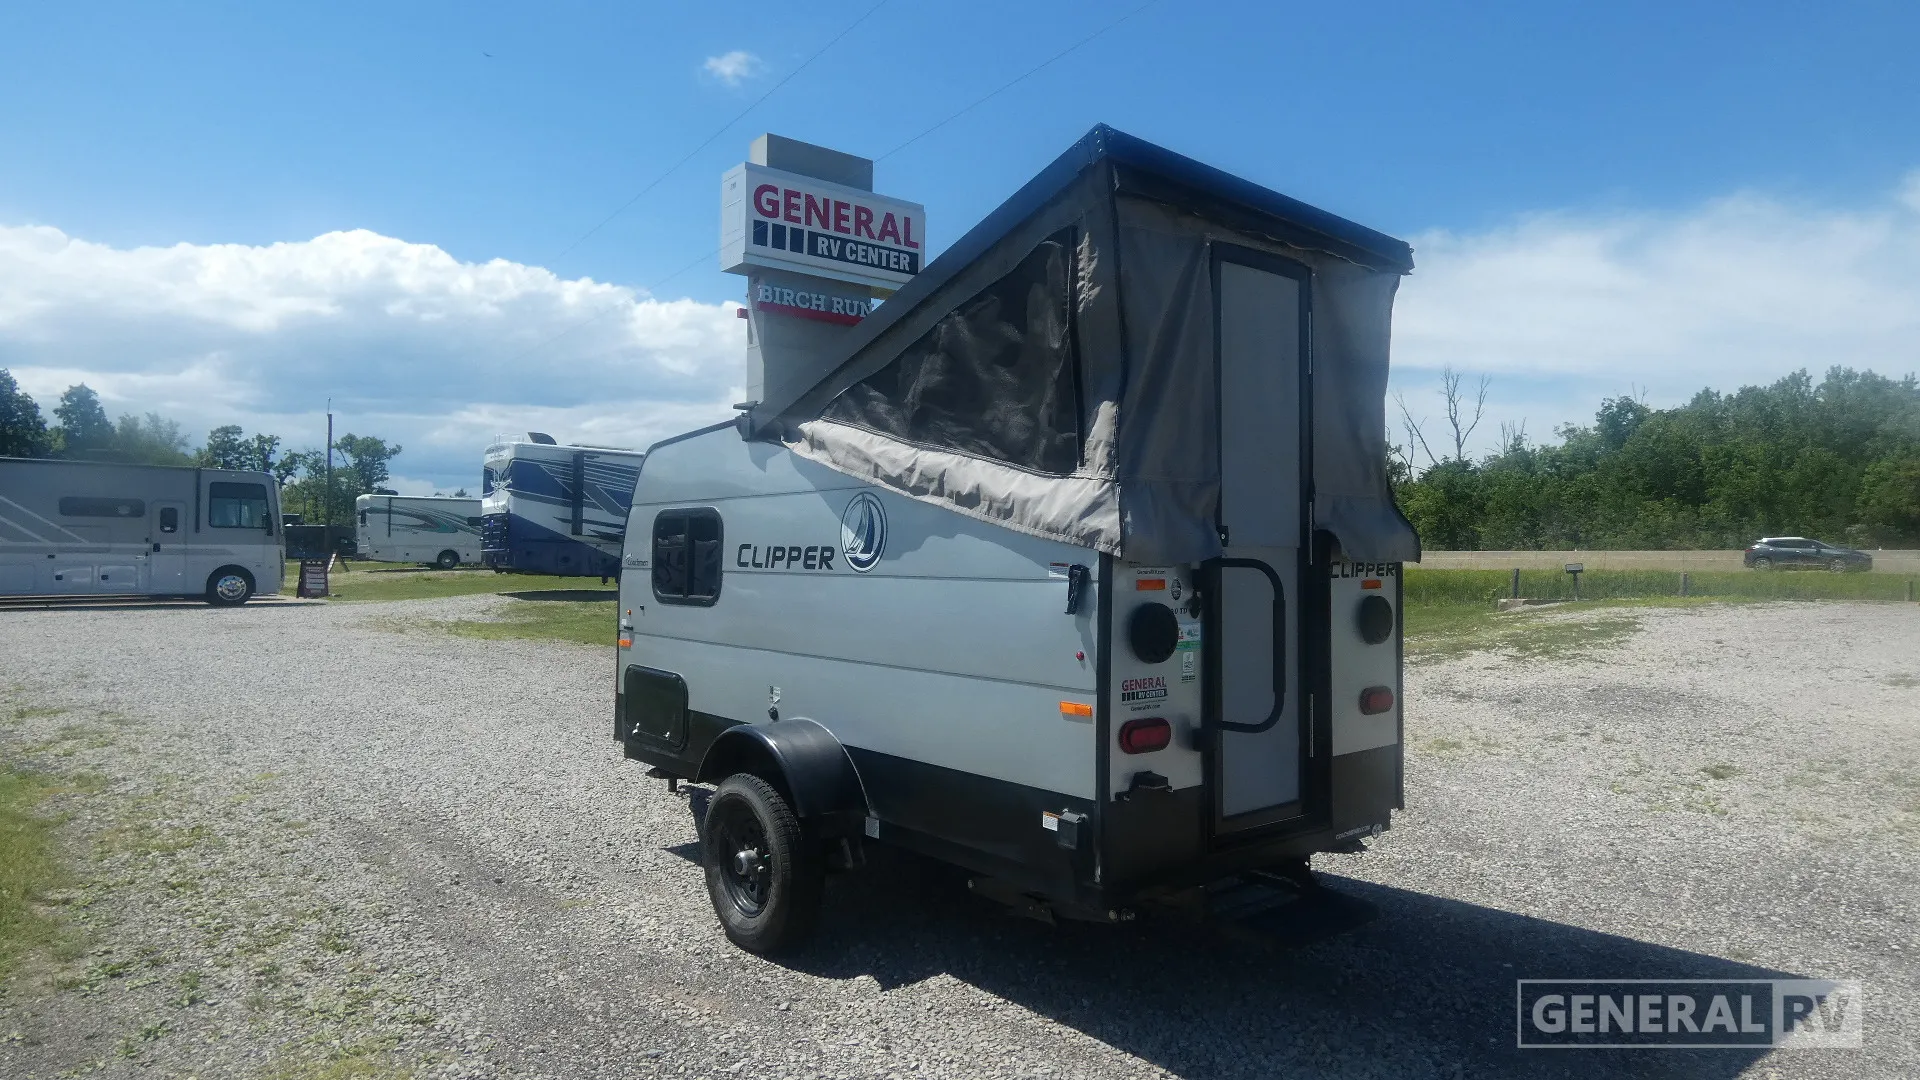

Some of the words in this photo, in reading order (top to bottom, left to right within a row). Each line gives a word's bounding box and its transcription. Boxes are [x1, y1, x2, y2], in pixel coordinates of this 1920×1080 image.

[753, 183, 919, 249] GENERAL
[817, 236, 841, 257] RV
[845, 242, 910, 271] CENTER
[758, 284, 826, 312] BIRCH
[832, 296, 874, 317] RUN
[737, 543, 835, 571] CLIPPER
[1330, 561, 1396, 579] CLIPPER
[1121, 676, 1167, 692] GENERAL
[1138, 691, 1146, 699] RV
[1146, 689, 1165, 698] CENTER
